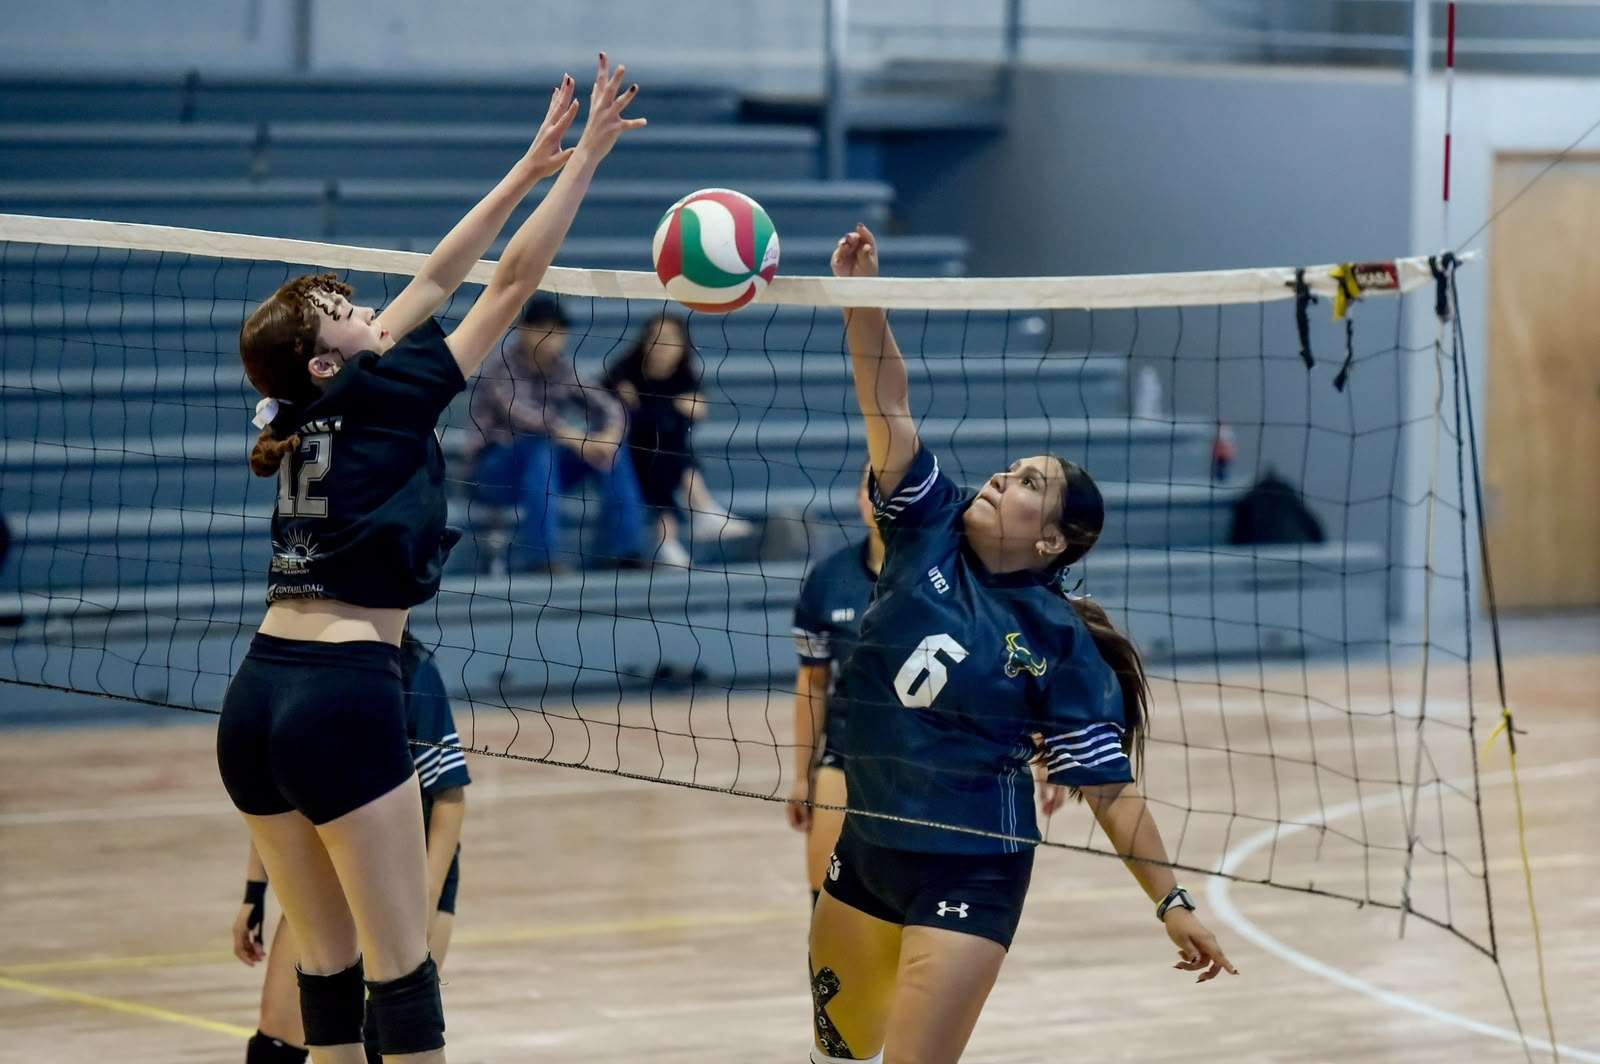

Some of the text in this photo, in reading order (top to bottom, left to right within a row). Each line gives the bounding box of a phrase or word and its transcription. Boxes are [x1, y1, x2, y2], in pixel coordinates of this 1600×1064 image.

[278, 432, 333, 518] 12
[928, 566, 949, 594] UTCJ
[893, 634, 969, 708] 6
